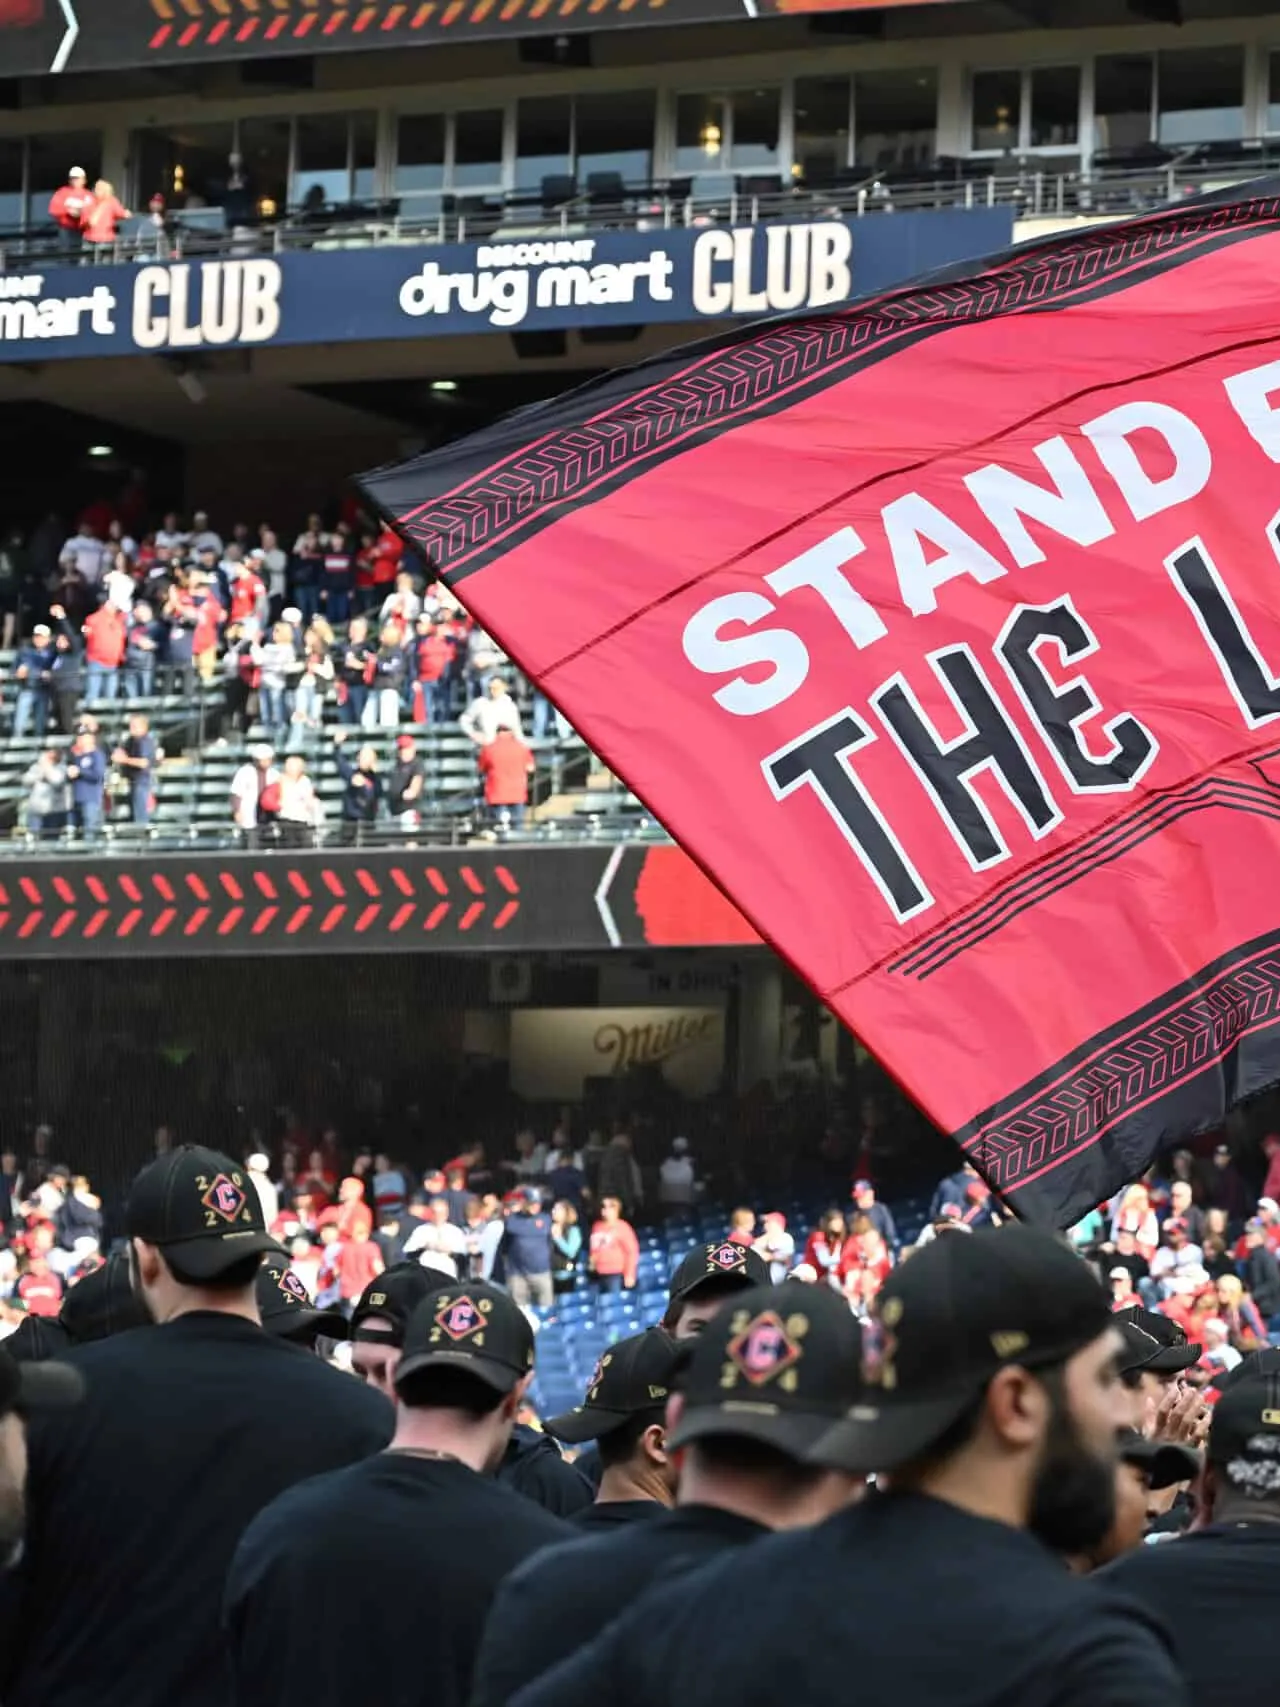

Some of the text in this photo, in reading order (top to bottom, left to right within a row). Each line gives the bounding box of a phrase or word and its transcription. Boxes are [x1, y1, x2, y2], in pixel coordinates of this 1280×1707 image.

[399, 250, 673, 327] drug mart
[476, 239, 596, 268] DISCOUNT
[692, 221, 853, 315] CLUB
[131, 258, 282, 348] CLUB
[683, 401, 1213, 717] STAND
[760, 593, 1160, 925] THE
[216, 1183, 236, 1211] C
[719, 1248, 735, 1263] C
[448, 1304, 474, 1331] C
